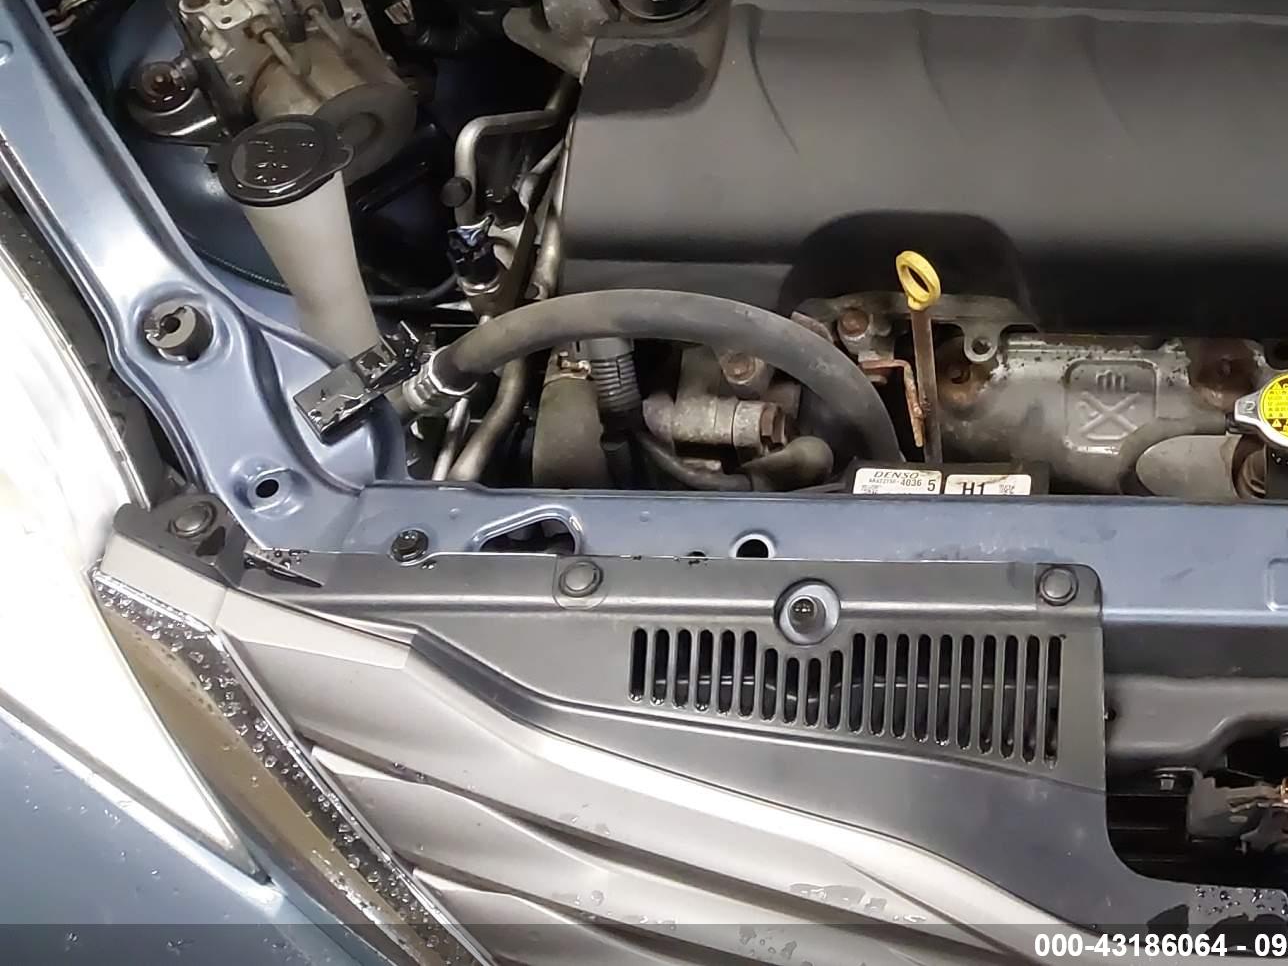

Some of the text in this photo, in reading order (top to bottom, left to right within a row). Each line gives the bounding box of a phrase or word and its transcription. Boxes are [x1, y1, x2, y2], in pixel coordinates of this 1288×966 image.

[873, 470, 920, 479] DENSO
[927, 479, 936, 492] 5
[962, 481, 986, 495] H1
